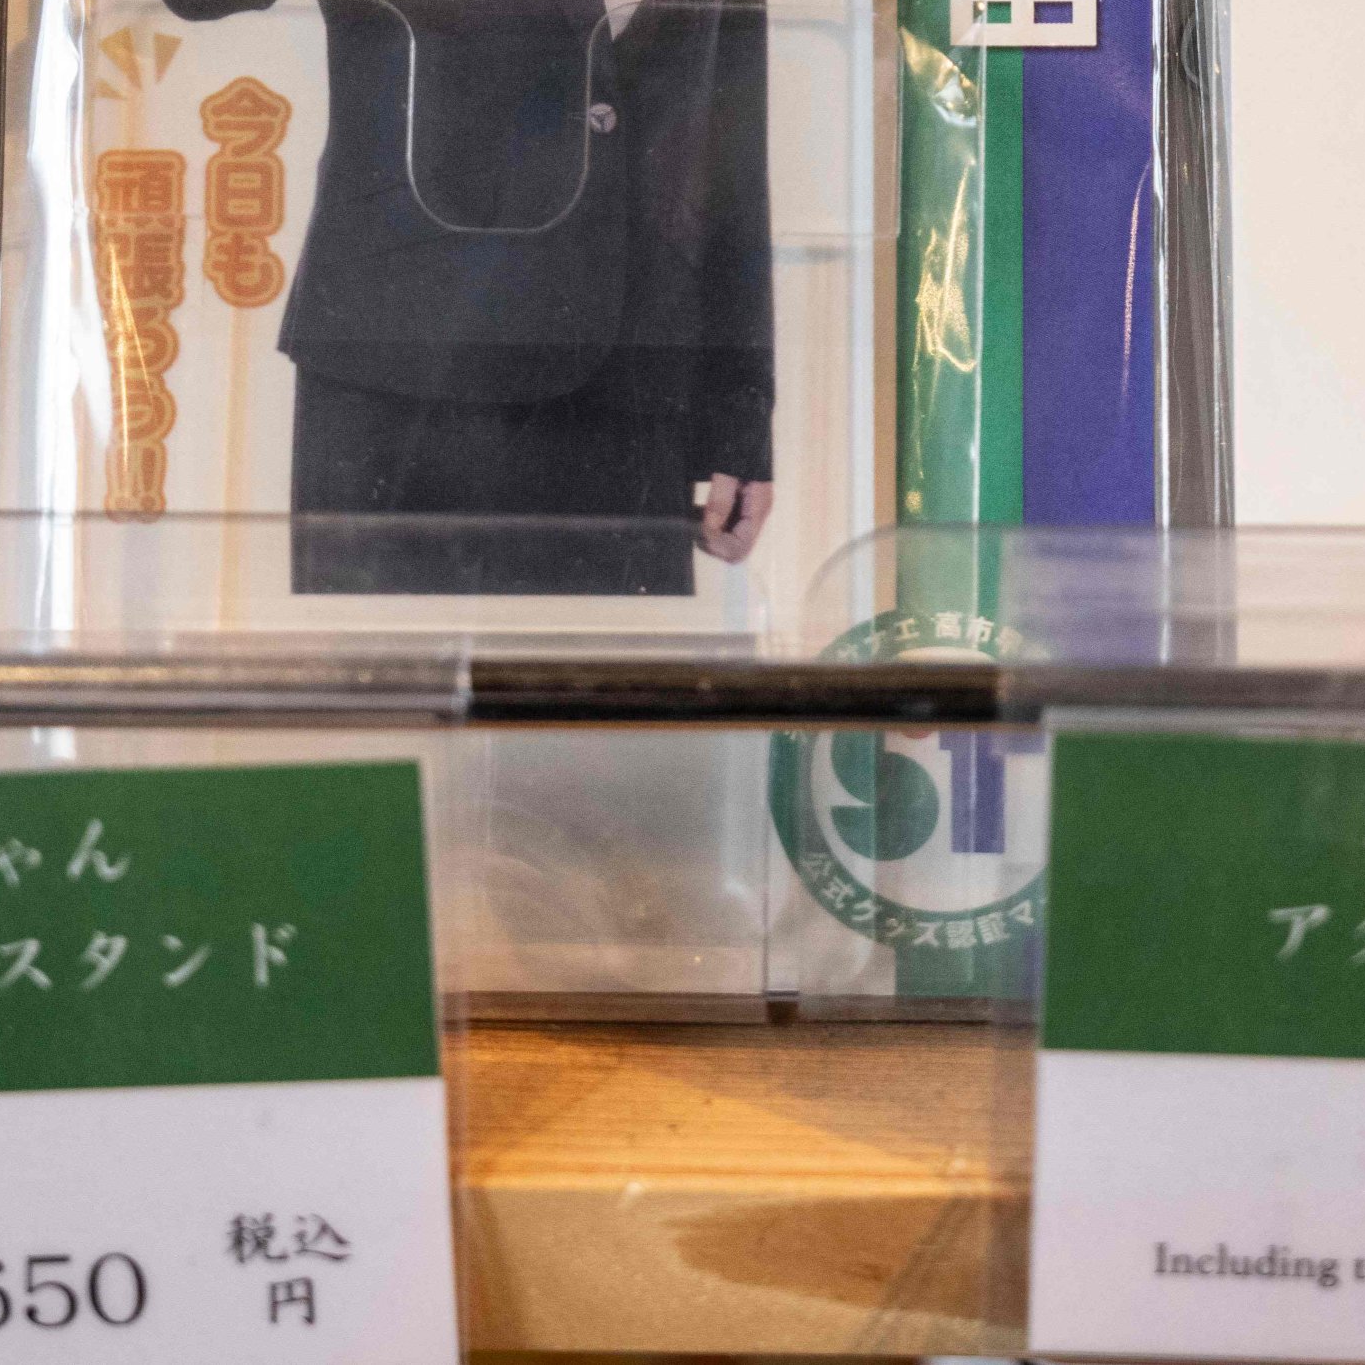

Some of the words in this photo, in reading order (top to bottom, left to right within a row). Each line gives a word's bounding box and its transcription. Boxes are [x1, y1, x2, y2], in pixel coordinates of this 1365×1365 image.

[200, 76, 292, 308] 今日も
[225, 1212, 352, 1267] 税込
[1152, 1240, 1339, 1289] Including
[266, 1276, 319, 1327] 円
